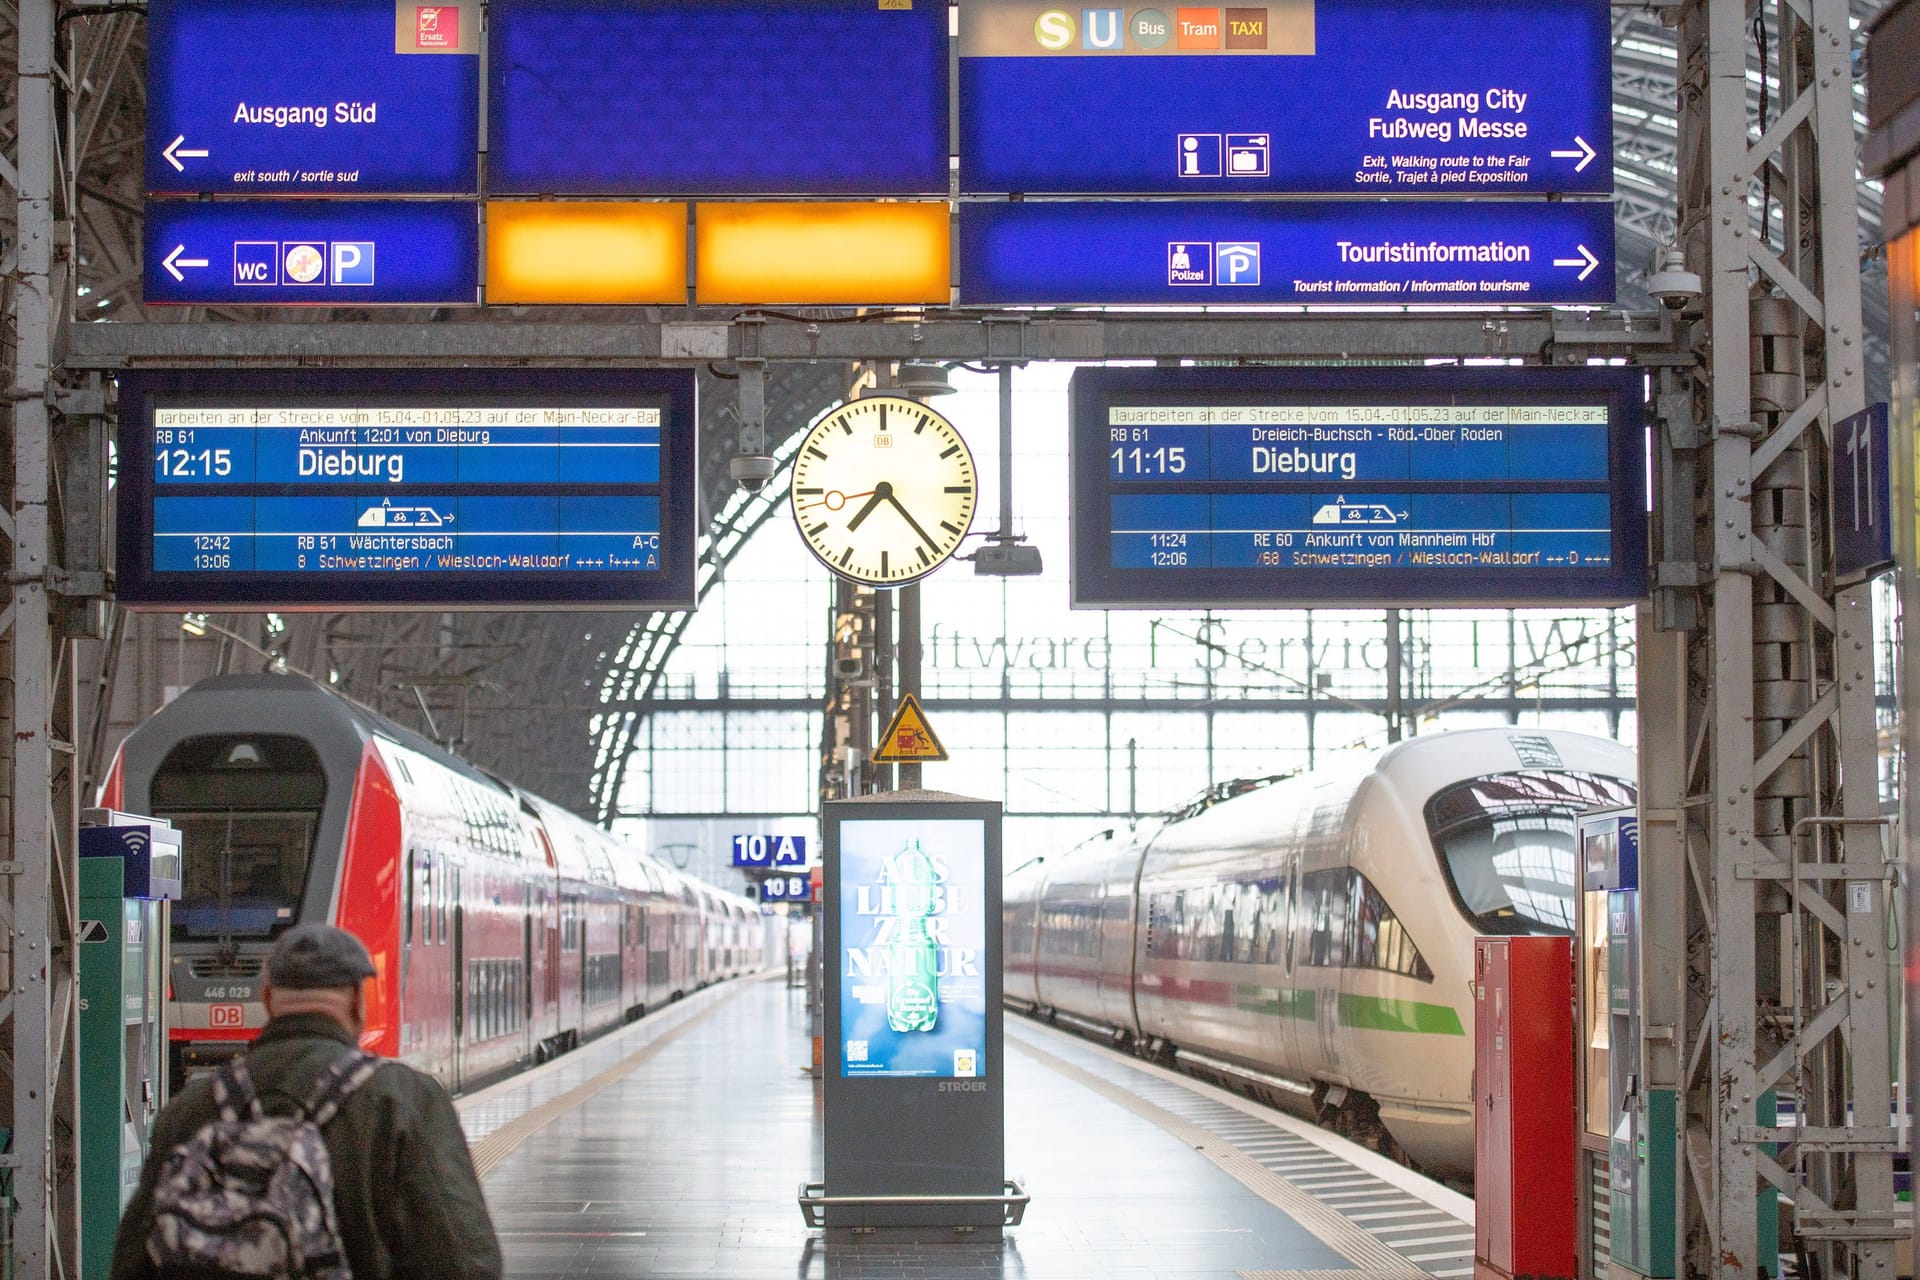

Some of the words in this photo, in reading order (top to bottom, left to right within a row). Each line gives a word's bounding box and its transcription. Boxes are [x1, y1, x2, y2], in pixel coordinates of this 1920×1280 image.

[1039, 12, 1067, 48] S
[1089, 11, 1116, 47] U
[1138, 21, 1165, 35] Bus
[1181, 22, 1217, 36] Tram
[1230, 21, 1263, 35] TAXI
[1386, 89, 1479, 114] Ausgang
[1486, 89, 1527, 113] City
[233, 102, 328, 128] Ausgang
[335, 102, 376, 123] Süd
[1369, 118, 1451, 142] Fußweg
[1458, 118, 1528, 138] Messe
[1363, 156, 1388, 169] Exit,
[1392, 156, 1437, 169] Walking
[1440, 156, 1470, 167] route
[1472, 156, 1484, 167] to
[1487, 155, 1506, 167] the
[1508, 155, 1531, 167] Fair
[233, 170, 256, 182] exit
[258, 170, 290, 182] south
[301, 170, 334, 182] sortie
[337, 170, 359, 182] sud
[1355, 172, 1393, 184] Sortie,
[1396, 171, 1429, 184] Trajet
[1431, 171, 1439, 182] à
[1441, 171, 1466, 184] pied
[1469, 171, 1528, 184] Exposition
[1336, 241, 1531, 263] Touristinformation
[237, 263, 268, 280] WC
[335, 245, 361, 283] P
[1230, 255, 1249, 283] P
[1171, 270, 1204, 281] Polizei
[1293, 280, 1332, 292] Tourist
[1335, 280, 1400, 292] information
[1411, 280, 1477, 292] Information
[1480, 280, 1530, 292] tourisme
[228, 414, 245, 424] an
[250, 411, 273, 424] der
[279, 411, 334, 424] Strecke
[340, 414, 369, 424] vom
[377, 411, 482, 424] 15.04.-01.05.23
[487, 411, 510, 424] auf
[515, 411, 537, 424] der
[1199, 411, 1216, 422] an
[1221, 409, 1242, 422] der
[1250, 409, 1304, 422] Strecke
[1310, 411, 1338, 422] vom
[1345, 409, 1449, 422] 15.04.-01.05.23
[1455, 409, 1478, 422] auf
[1483, 409, 1505, 422] der
[156, 430, 173, 444] RB
[178, 430, 195, 444] 61
[300, 429, 357, 443] Ankunft
[363, 429, 400, 443] 12:01
[405, 431, 432, 443] von
[436, 429, 490, 445] Dieburg
[877, 437, 890, 446] DB
[1110, 428, 1128, 442] RB
[1132, 428, 1149, 442] 61
[1252, 427, 1372, 442] Dreieich-Buchsch
[1388, 427, 1456, 442] Röd.-Ober
[1461, 427, 1503, 442] Roden
[156, 449, 232, 477] 12:15
[298, 449, 404, 483] Dieburg
[1110, 447, 1187, 474] 11:15
[1252, 447, 1356, 480] Dieburg
[1846, 413, 1873, 532] 11
[383, 496, 391, 507] A
[1336, 494, 1345, 505] A
[193, 536, 231, 550] 12:42
[297, 536, 315, 550] RB
[320, 536, 336, 550] 51
[350, 536, 453, 550] Wächtersbach
[632, 535, 659, 549] A-C
[1149, 533, 1187, 547] 11:24
[1254, 533, 1271, 547] RE
[1276, 533, 1293, 547] 60
[1305, 533, 1363, 547] Ankunft
[1368, 535, 1394, 547] von
[1399, 533, 1467, 547] Mannheim
[1472, 533, 1496, 547] Hbf
[193, 554, 231, 568] 13:06
[319, 554, 419, 571] Schwetzingen
[437, 554, 570, 568] Wiesloch-Walldorf
[1149, 551, 1187, 566] 12:06
[1292, 551, 1392, 568] Schwetzingen
[1410, 551, 1541, 565] Wiesloch-Walldorf
[920, 622, 1112, 670] ftware
[735, 835, 767, 861] 10
[776, 836, 798, 861] A
[764, 877, 785, 896] 10
[789, 877, 803, 896] B
[846, 947, 979, 977] NATUR
[204, 987, 226, 998] 446
[229, 987, 251, 998] 029
[214, 1008, 240, 1024] DB
[938, 1081, 986, 1092] STRÖER
